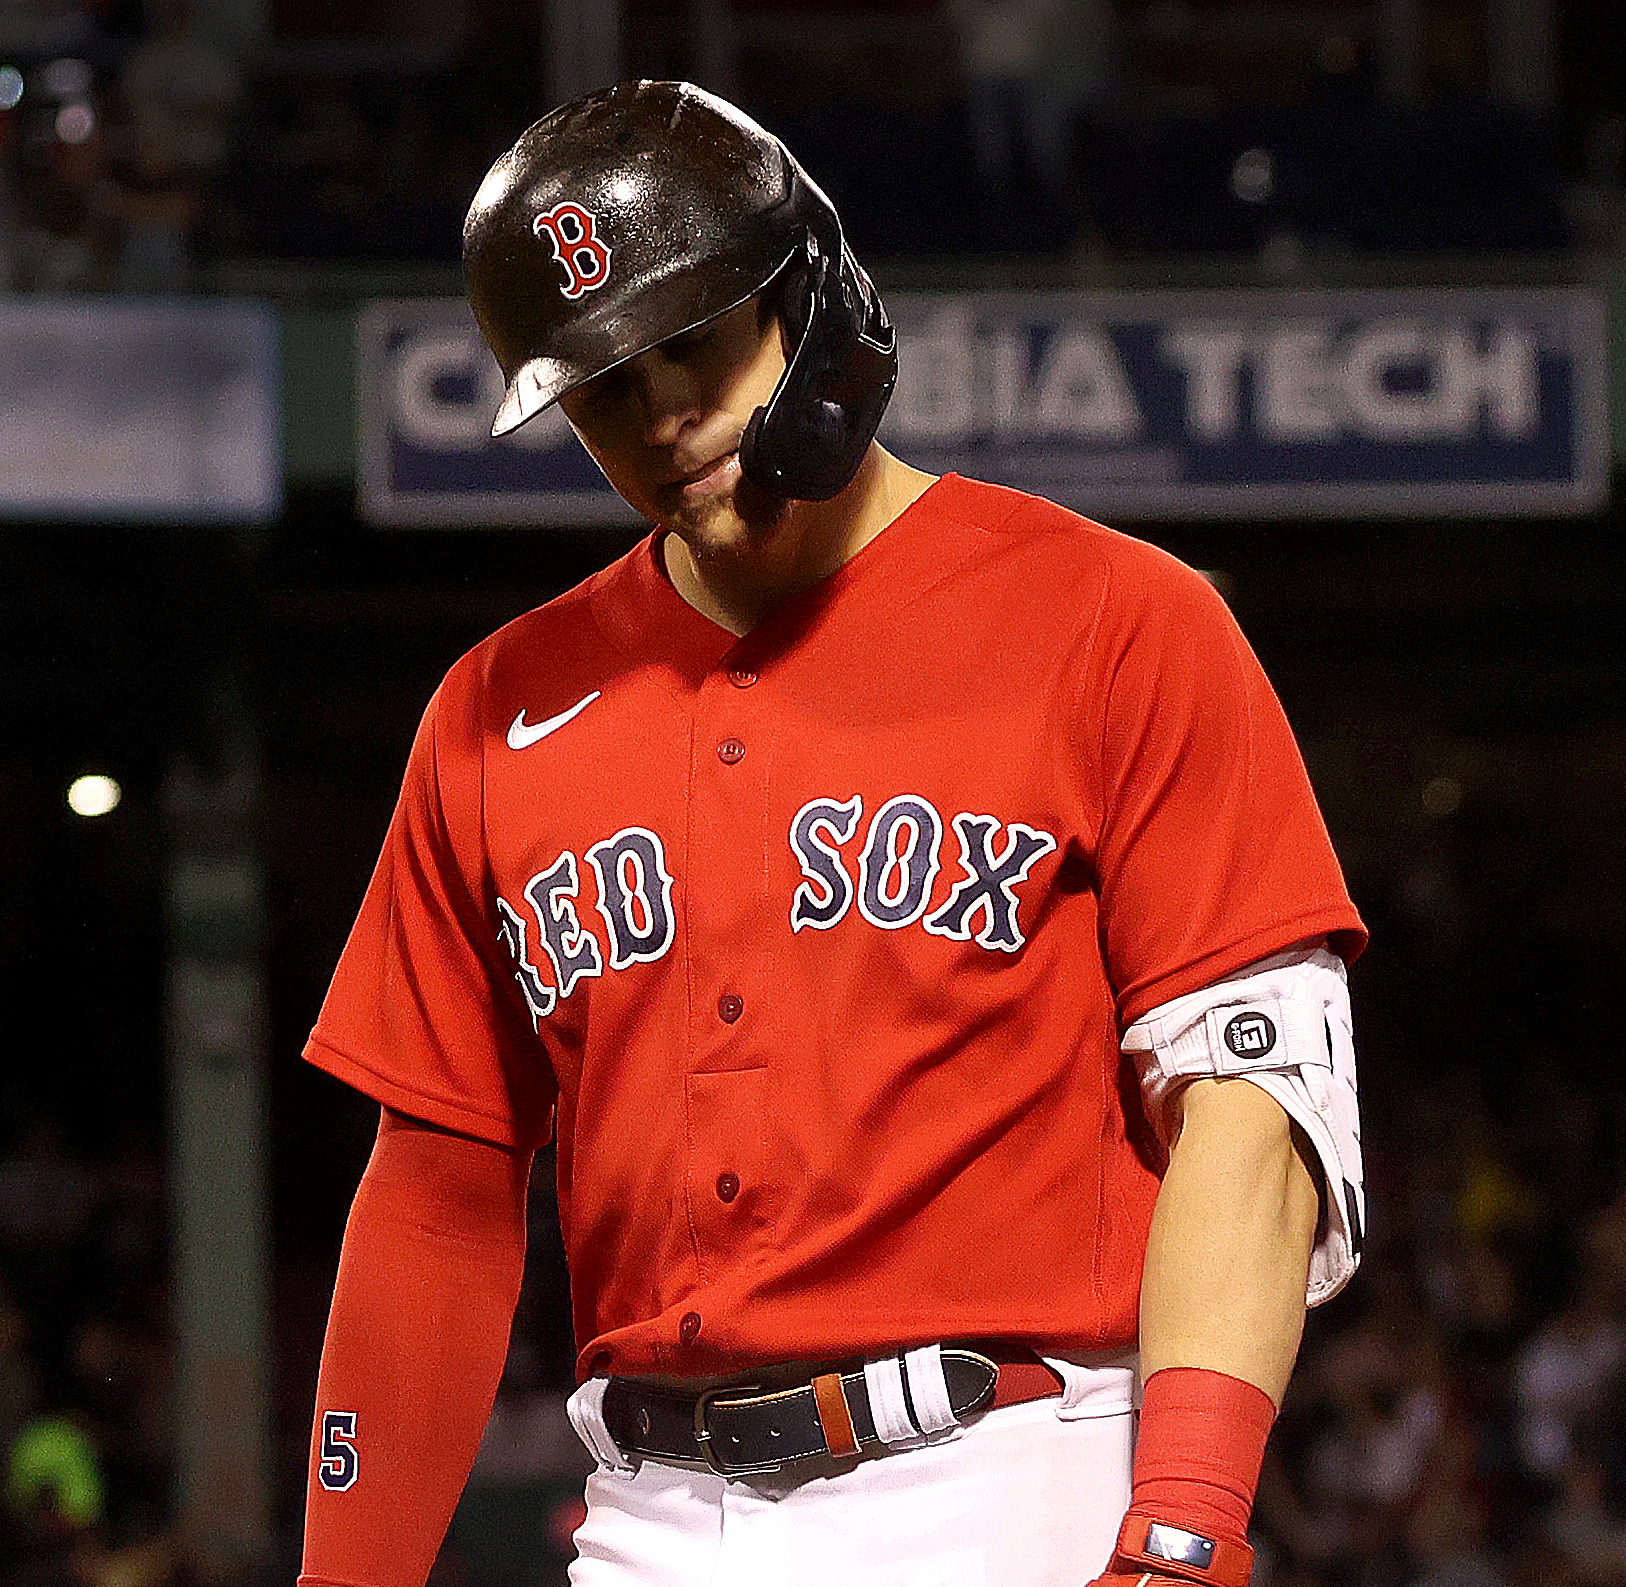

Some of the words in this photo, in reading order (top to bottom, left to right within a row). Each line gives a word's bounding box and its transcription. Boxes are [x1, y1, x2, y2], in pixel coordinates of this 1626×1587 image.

[533, 201, 612, 299] B
[1167, 325, 1541, 442] TECH
[789, 794, 1057, 953] SOX
[318, 1410, 359, 1492] 5
